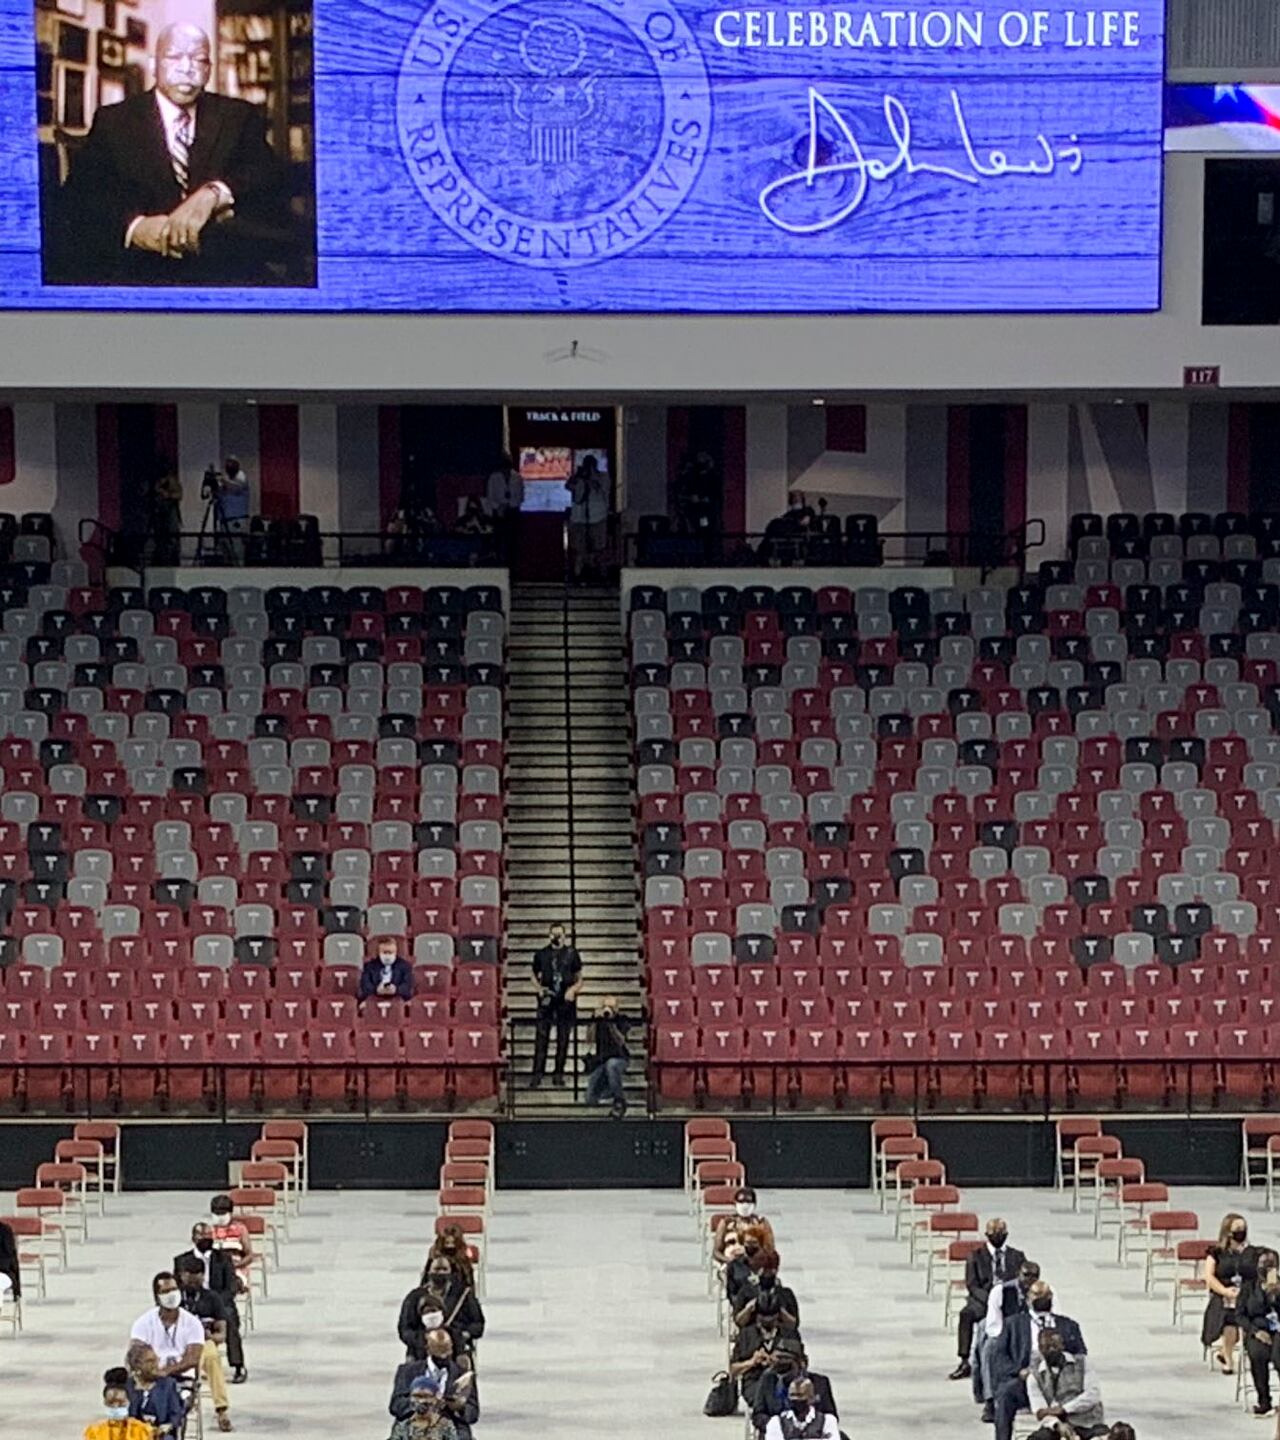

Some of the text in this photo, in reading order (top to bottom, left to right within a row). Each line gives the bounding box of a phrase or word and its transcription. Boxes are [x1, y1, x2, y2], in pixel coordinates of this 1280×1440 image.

[714, 10, 1141, 47] CELEBRATION OF LIFE
[406, 117, 703, 259] REPRESENTATIVES
[1191, 369, 1214, 383] 117
[526, 411, 602, 422] TRACK & FIELD
